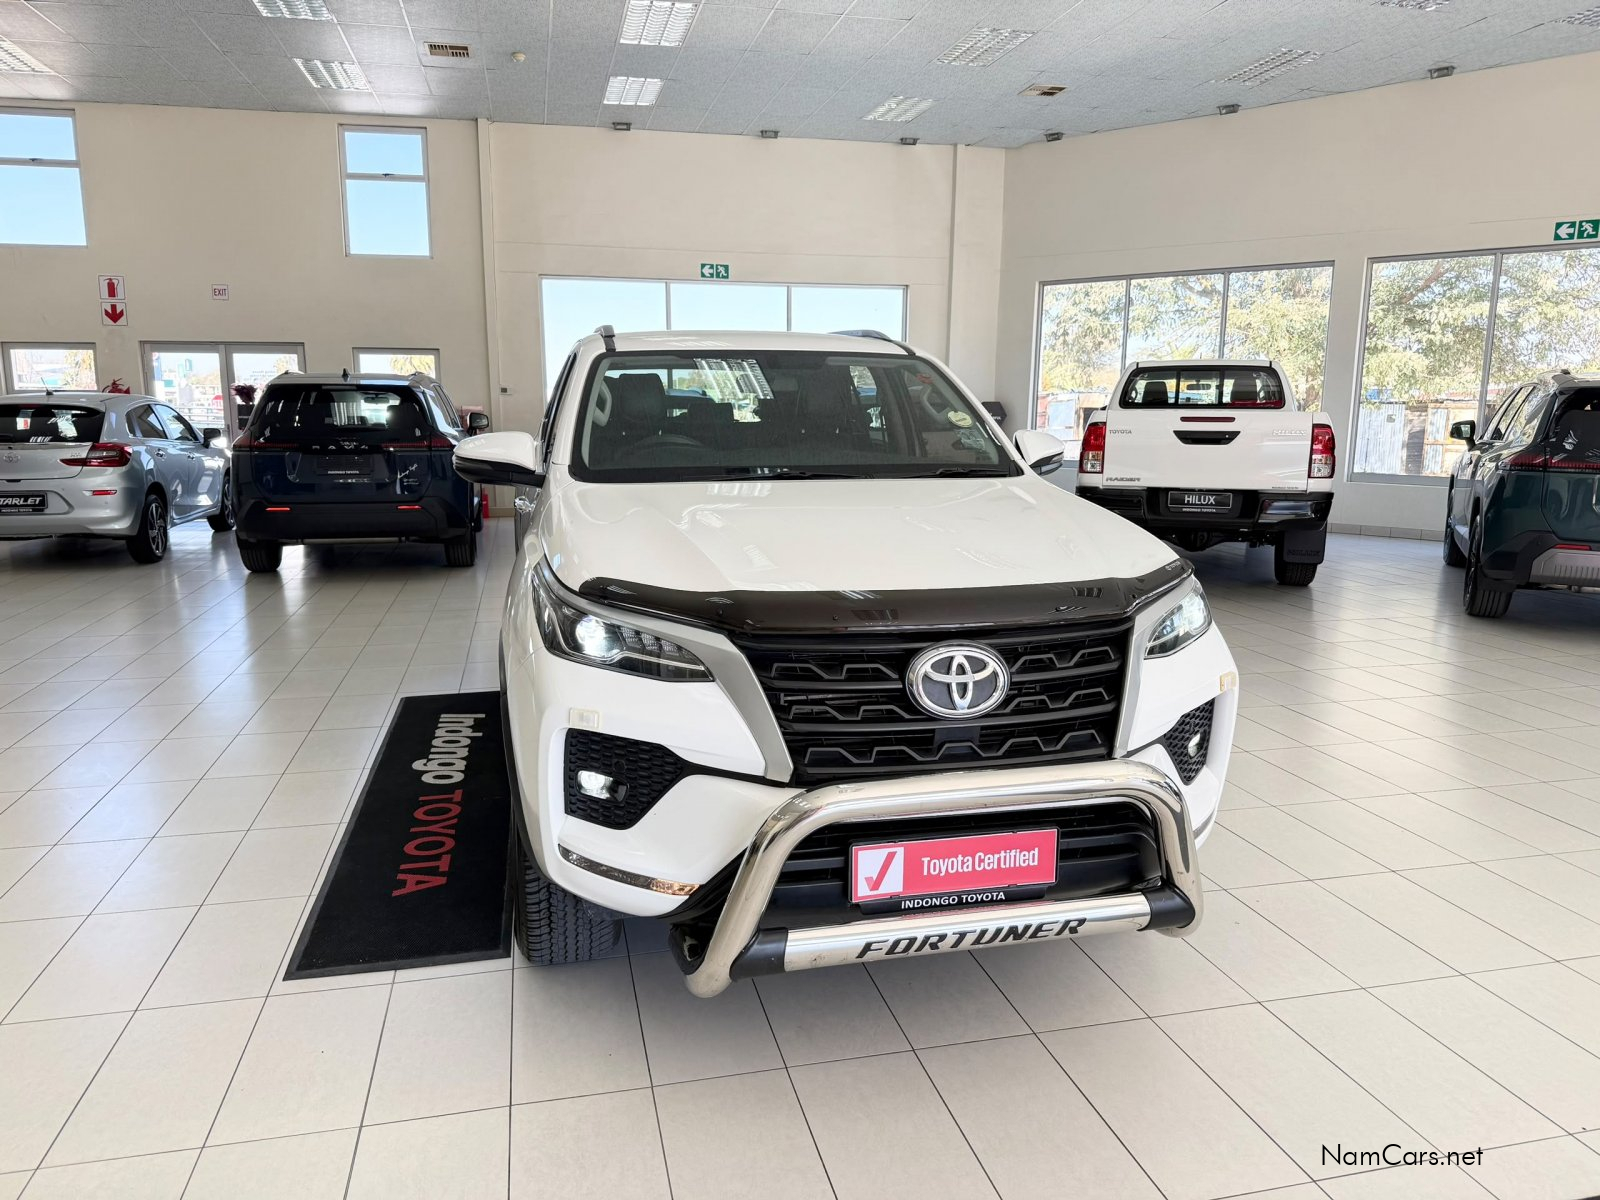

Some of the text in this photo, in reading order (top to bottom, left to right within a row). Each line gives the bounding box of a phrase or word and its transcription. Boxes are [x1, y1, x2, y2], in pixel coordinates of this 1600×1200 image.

[213, 288, 227, 297] EXIT
[1184, 494, 1216, 505] HILUX
[391, 713, 486, 897] Indongo TOYOTA
[921, 847, 1039, 877] Toyota Certified
[901, 891, 1006, 910] INDONGO TOYOTA
[855, 917, 1087, 959] FORTUNER
